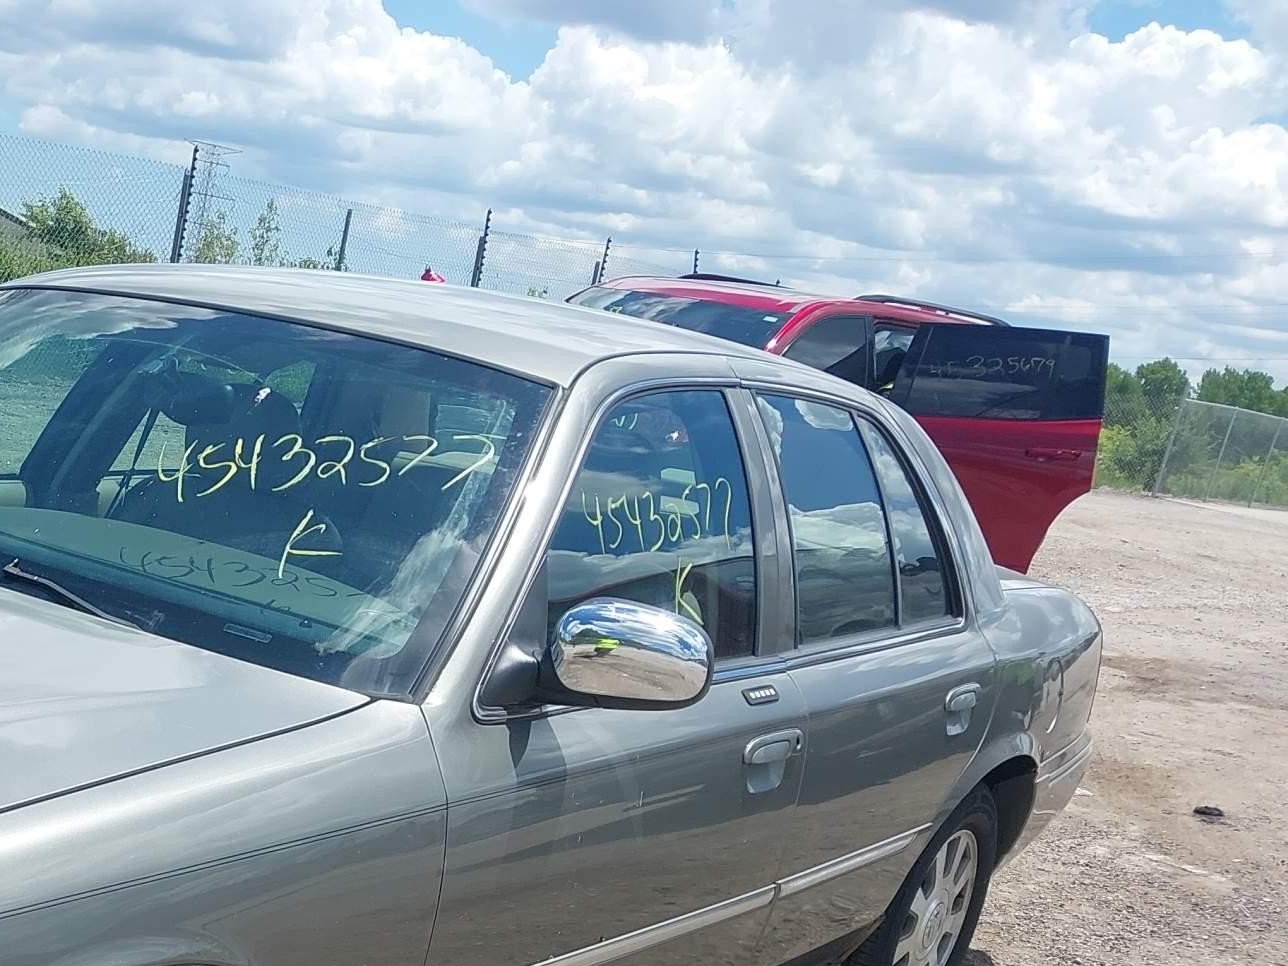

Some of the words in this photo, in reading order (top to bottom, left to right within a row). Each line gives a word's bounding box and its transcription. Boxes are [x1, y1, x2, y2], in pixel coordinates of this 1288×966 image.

[157, 433, 507, 503] 45432577
[278, 508, 343, 578] K
[580, 477, 732, 556] 45432577
[674, 556, 705, 627] K
